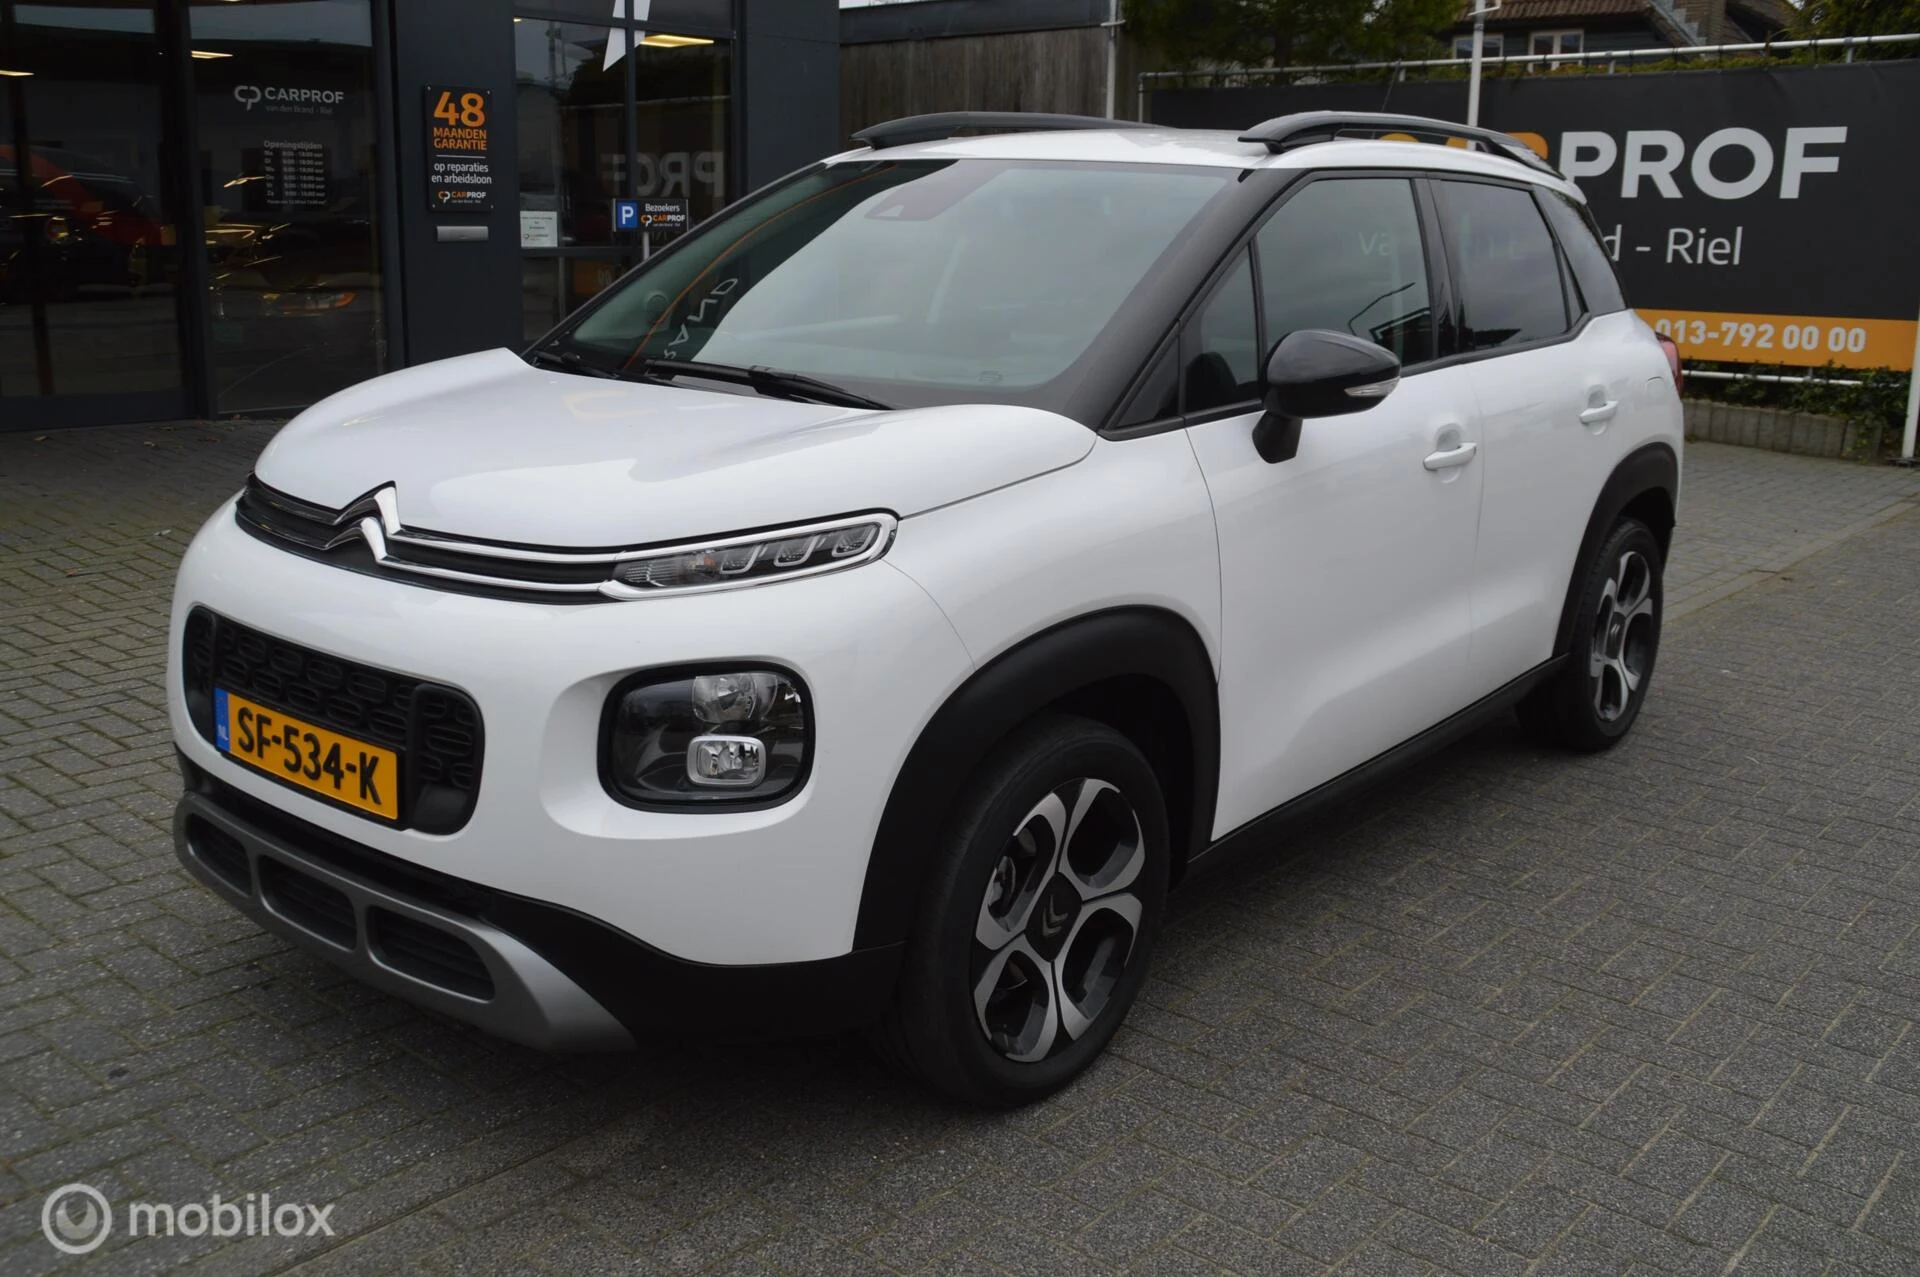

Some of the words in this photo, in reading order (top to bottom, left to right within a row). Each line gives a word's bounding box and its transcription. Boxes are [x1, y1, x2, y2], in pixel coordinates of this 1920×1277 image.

[264, 87, 344, 103] CARPROF
[433, 91, 486, 128] 48
[433, 127, 487, 140] MAANDEN
[433, 138, 487, 151] GARANTIE
[434, 163, 446, 173] op
[447, 162, 489, 173] reparaties
[431, 174, 442, 183] en
[444, 173, 492, 184] arbeidsloon
[451, 191, 487, 199] CARPROF
[645, 203, 680, 212] Bezoekers
[621, 206, 634, 225] P
[652, 214, 686, 223] CARPROF
[1665, 226, 1743, 265] Riel
[1656, 318, 1775, 349] 013-792
[1782, 324, 1820, 351] 00
[1827, 327, 1866, 353] 00
[238, 706, 382, 806] SF-534-K
